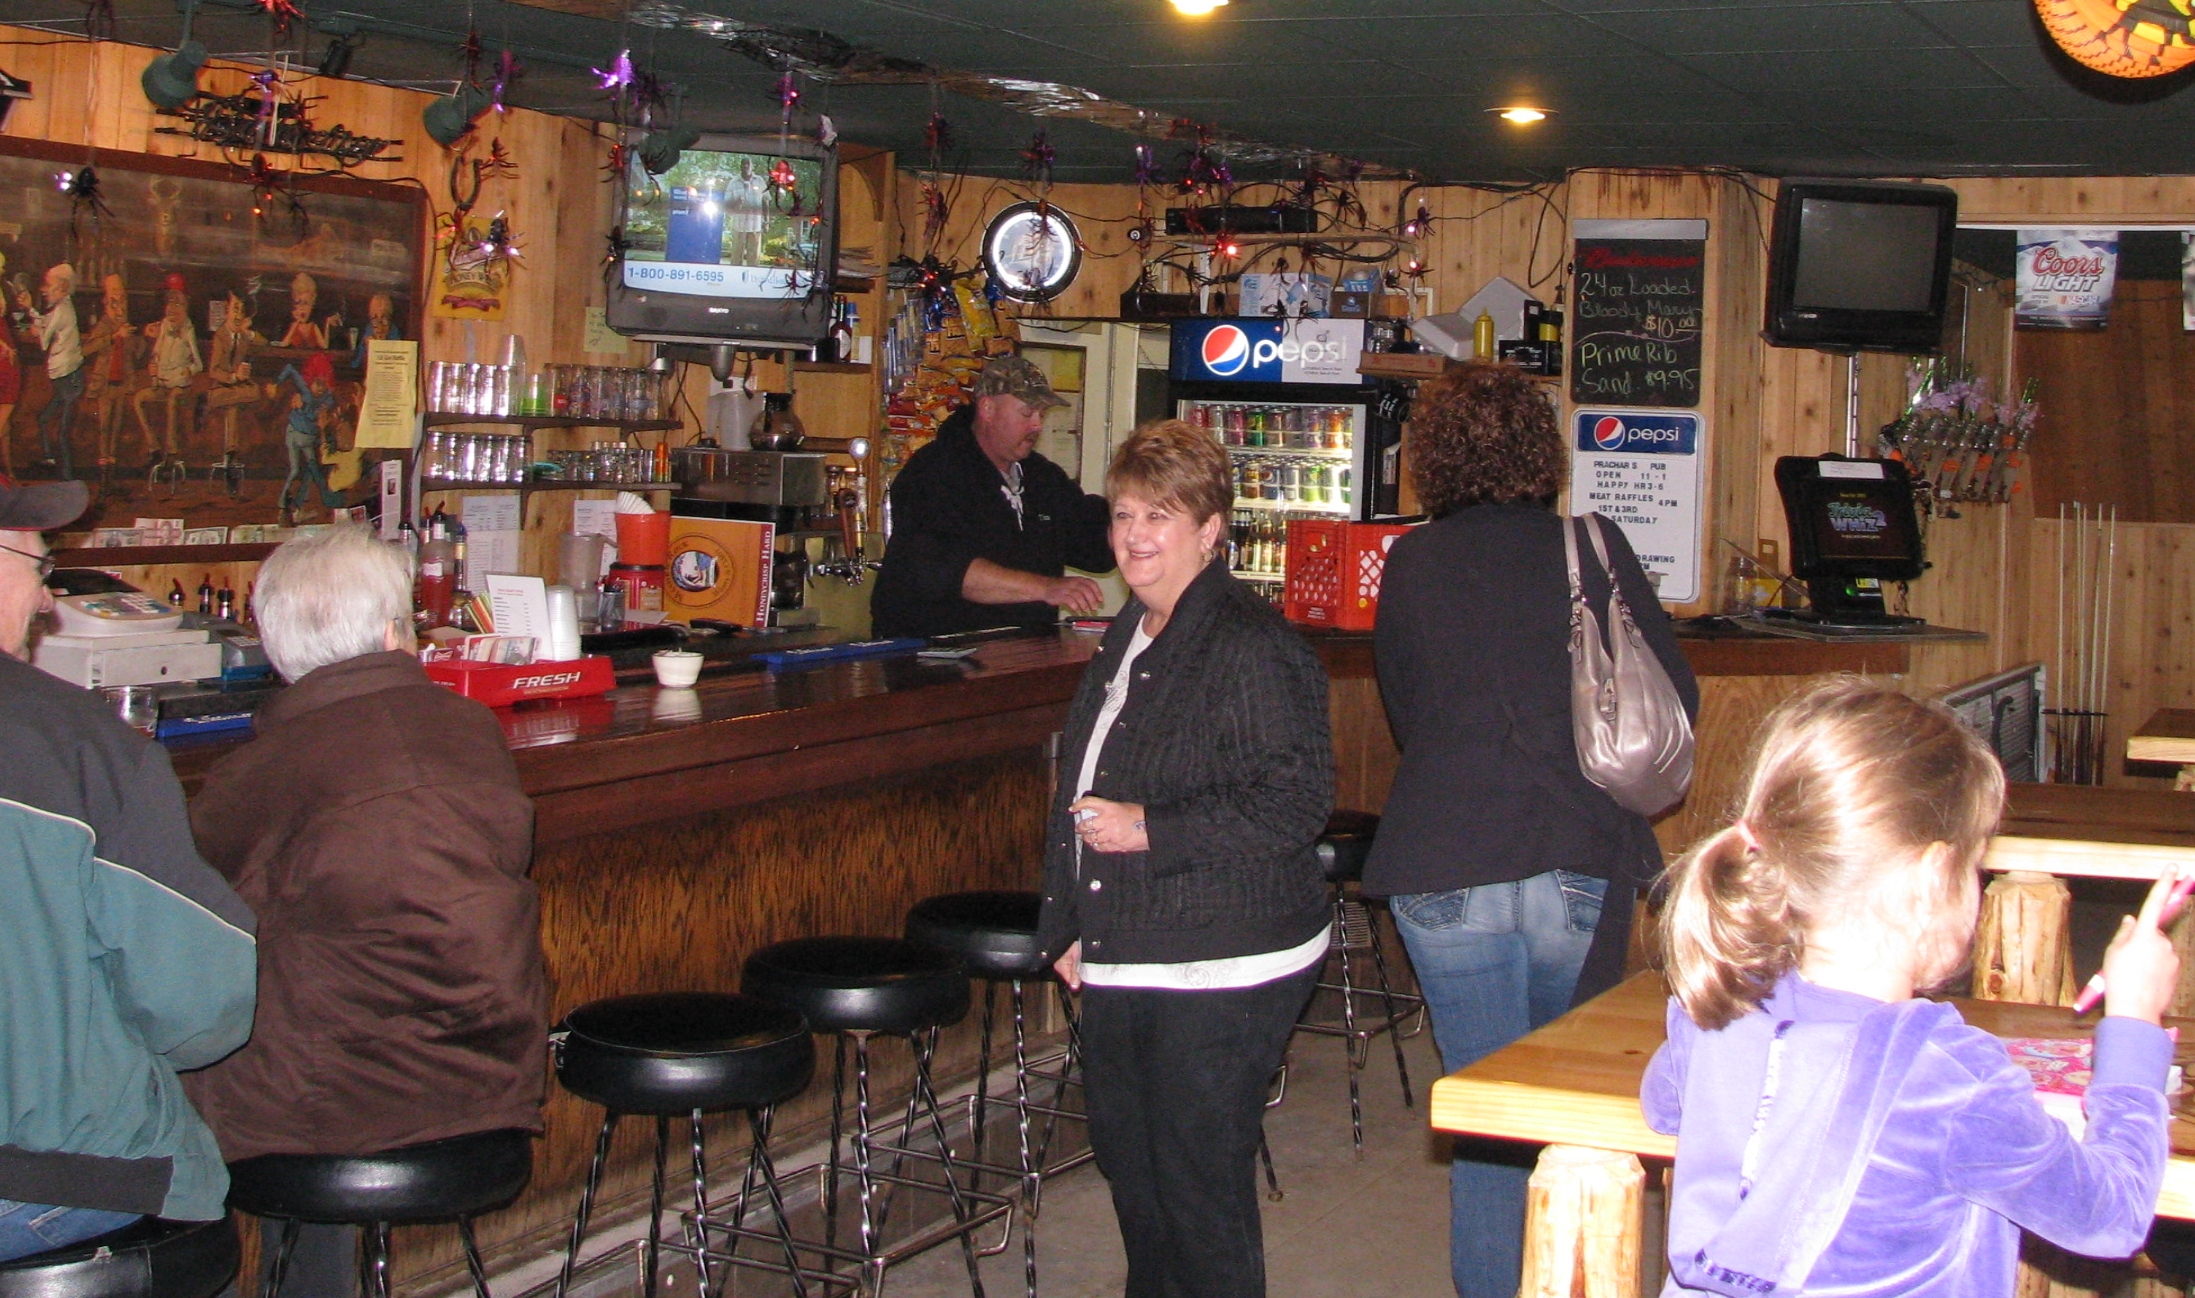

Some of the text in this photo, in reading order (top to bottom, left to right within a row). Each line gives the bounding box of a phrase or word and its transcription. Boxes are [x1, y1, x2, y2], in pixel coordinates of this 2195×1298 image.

[2032, 247, 2105, 276] Coors
[627, 267, 724, 282] 1-800-891-6595
[1581, 272, 1606, 297] 24
[1608, 286, 1625, 297] oz
[2032, 275, 2101, 292] LIGHT
[1578, 300, 1703, 322] Bloody Mary
[1253, 336, 1348, 368] pepsi
[1581, 342, 1677, 368] Prime Rib
[1627, 426, 1679, 444] pepsi
[1597, 481, 1628, 489] HAPPY
[1589, 492, 1653, 502] MEAT RAFFLES
[761, 531, 771, 560] HARD
[512, 671, 581, 689] FRESH
